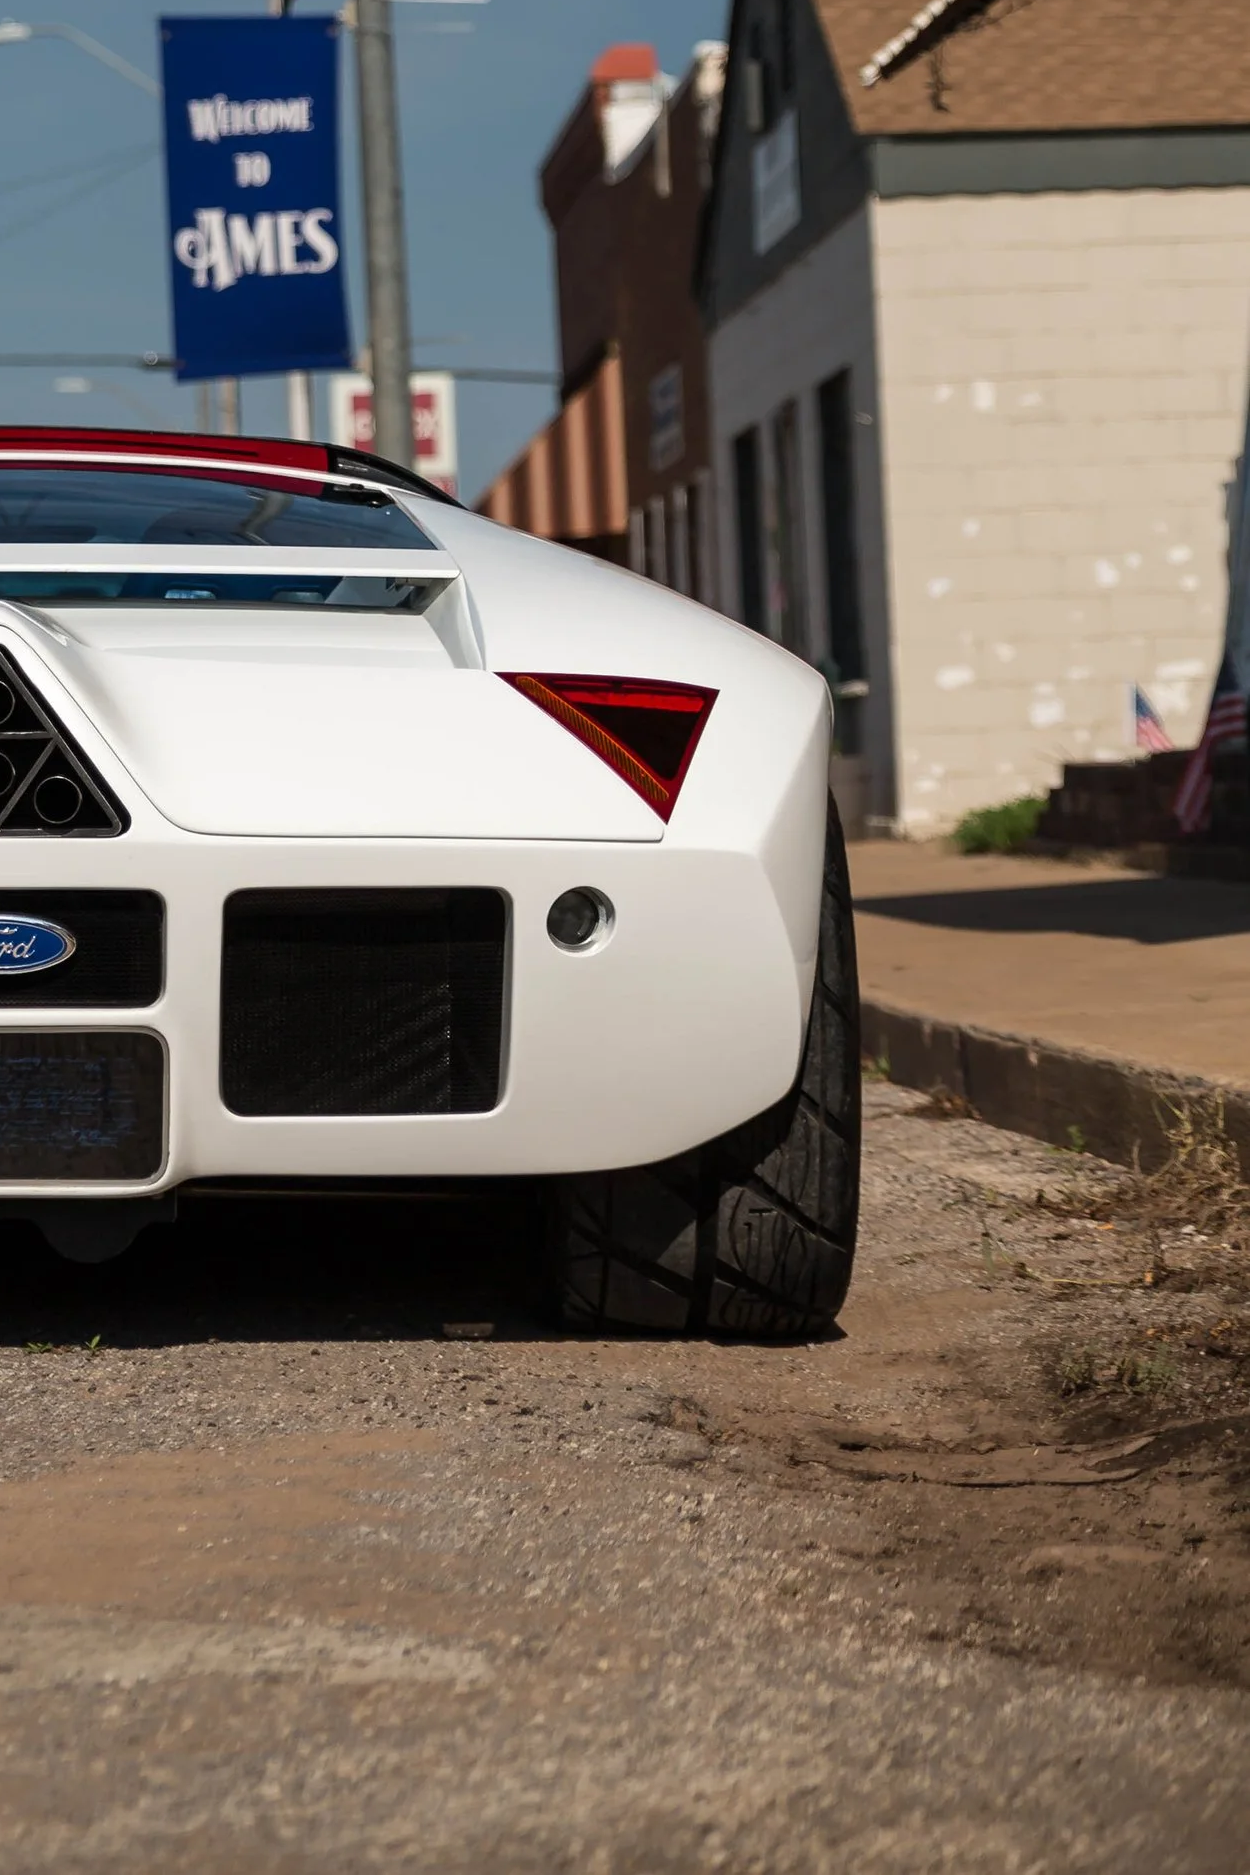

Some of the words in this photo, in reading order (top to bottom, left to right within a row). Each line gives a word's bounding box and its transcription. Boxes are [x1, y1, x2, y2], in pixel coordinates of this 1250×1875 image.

[187, 93, 314, 144] WELCOME
[232, 150, 271, 188] TO
[174, 207, 338, 292] AMES
